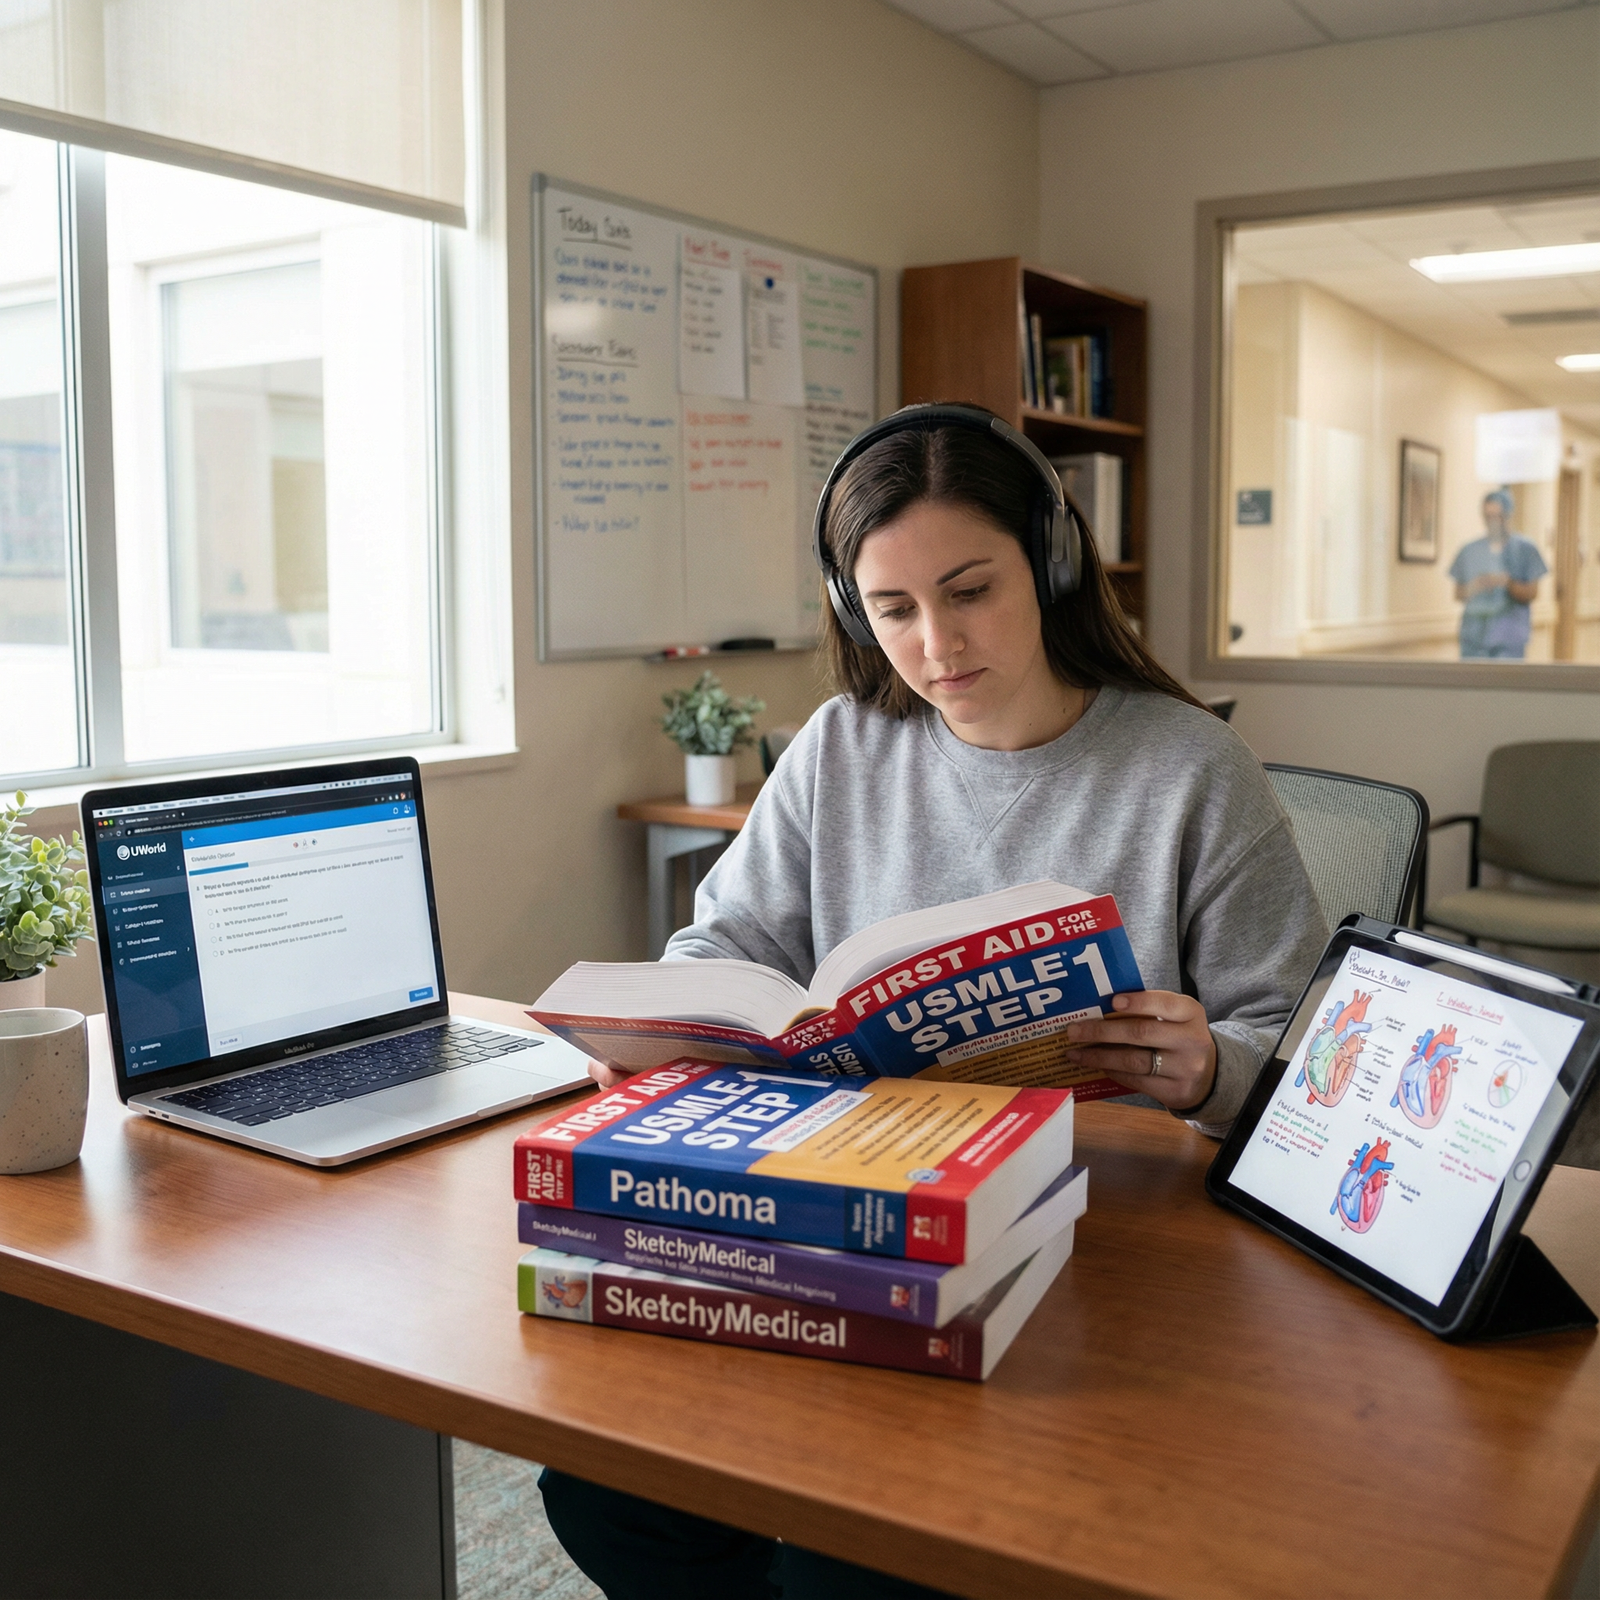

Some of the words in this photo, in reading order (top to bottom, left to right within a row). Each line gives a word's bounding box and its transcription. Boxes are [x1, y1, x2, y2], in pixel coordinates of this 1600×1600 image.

[130, 842, 167, 857] UWorld
[1057, 909, 1093, 926] FOR
[1060, 918, 1098, 936] THE
[849, 946, 966, 1018] FIRST
[983, 921, 1055, 960] AID
[885, 952, 1069, 1033] USMLE
[1072, 942, 1114, 997] 1
[911, 987, 1063, 1053] STEP
[538, 1093, 636, 1142] FIRST
[629, 1071, 689, 1097] AID
[610, 1078, 759, 1146] USMLE
[682, 1092, 799, 1150] STEP
[527, 1150, 541, 1199] FIRST
[542, 1171, 555, 1200] AID
[610, 1169, 776, 1225] Pathoma
[624, 1228, 775, 1275] SketchyMedical
[604, 1286, 846, 1348] SketchyMedical
